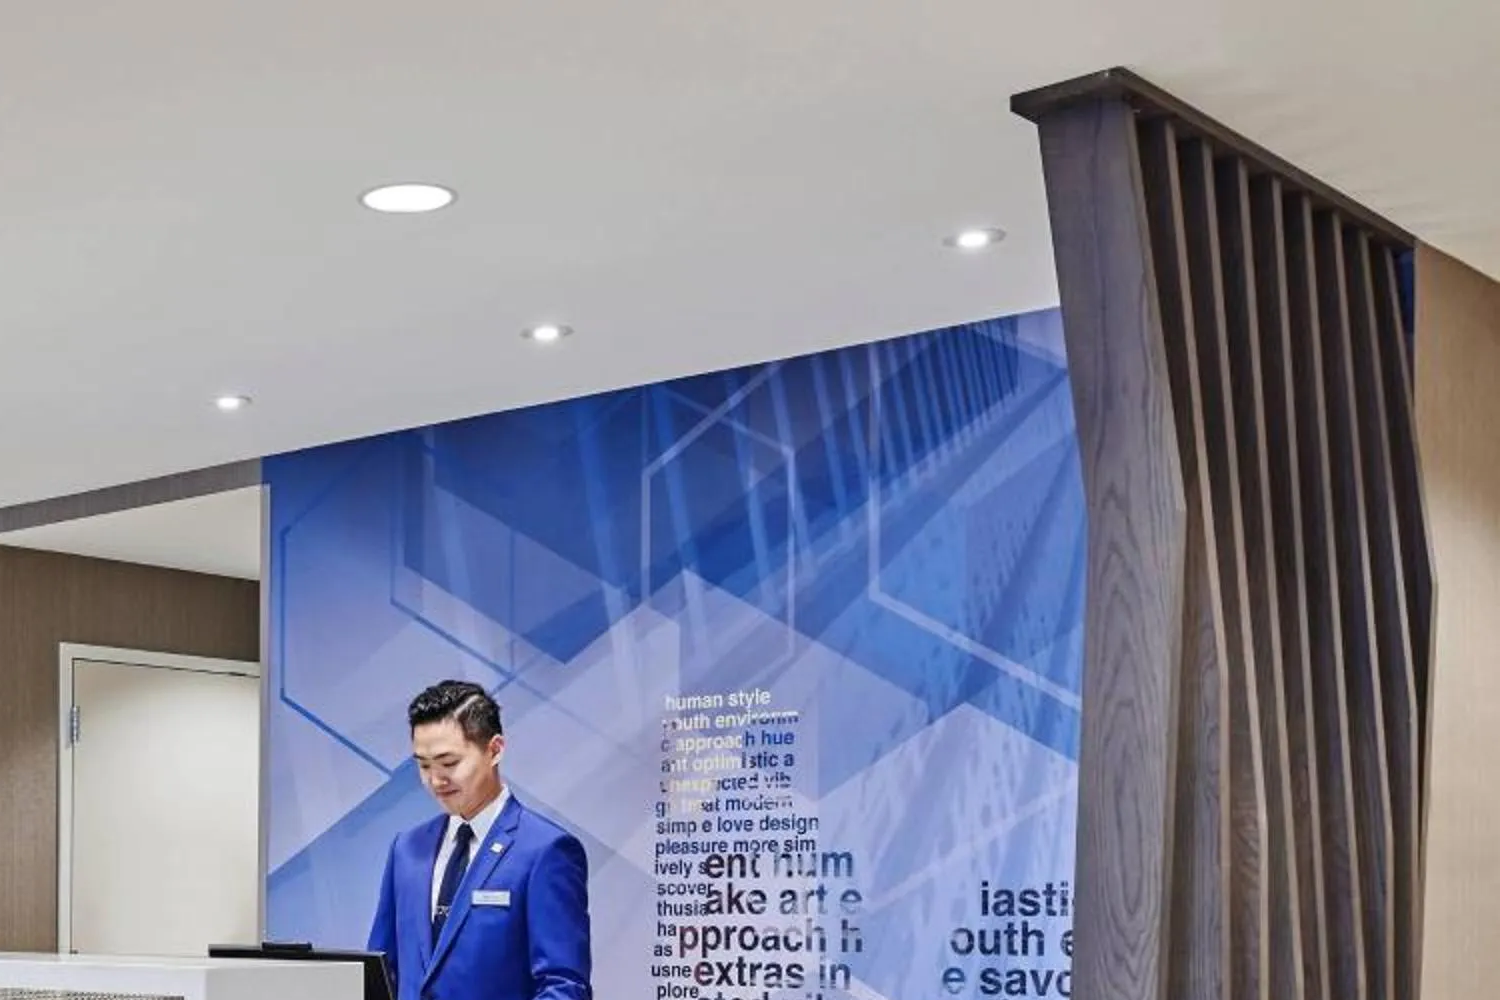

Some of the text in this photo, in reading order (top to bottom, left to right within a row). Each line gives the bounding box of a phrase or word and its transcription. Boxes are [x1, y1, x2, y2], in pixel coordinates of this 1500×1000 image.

[664, 688, 772, 711] human style
[675, 730, 756, 754] approach
[761, 730, 795, 745] hue
[783, 753, 795, 768] a
[717, 816, 753, 832] love
[759, 813, 819, 835] design
[655, 835, 816, 858] pleasure more sim
[654, 859, 693, 879] ively
[705, 852, 761, 879] ent
[657, 883, 713, 897] scover
[706, 882, 863, 915] ake art e
[980, 880, 1074, 917] iasti
[657, 900, 709, 917] thusia
[657, 921, 677, 937] ha
[678, 918, 827, 958] pproach
[950, 920, 1045, 957] outh
[653, 944, 673, 957] as
[651, 963, 692, 978] usne
[693, 956, 851, 990] extras in
[941, 967, 966, 995] e
[657, 983, 699, 1000] plore
